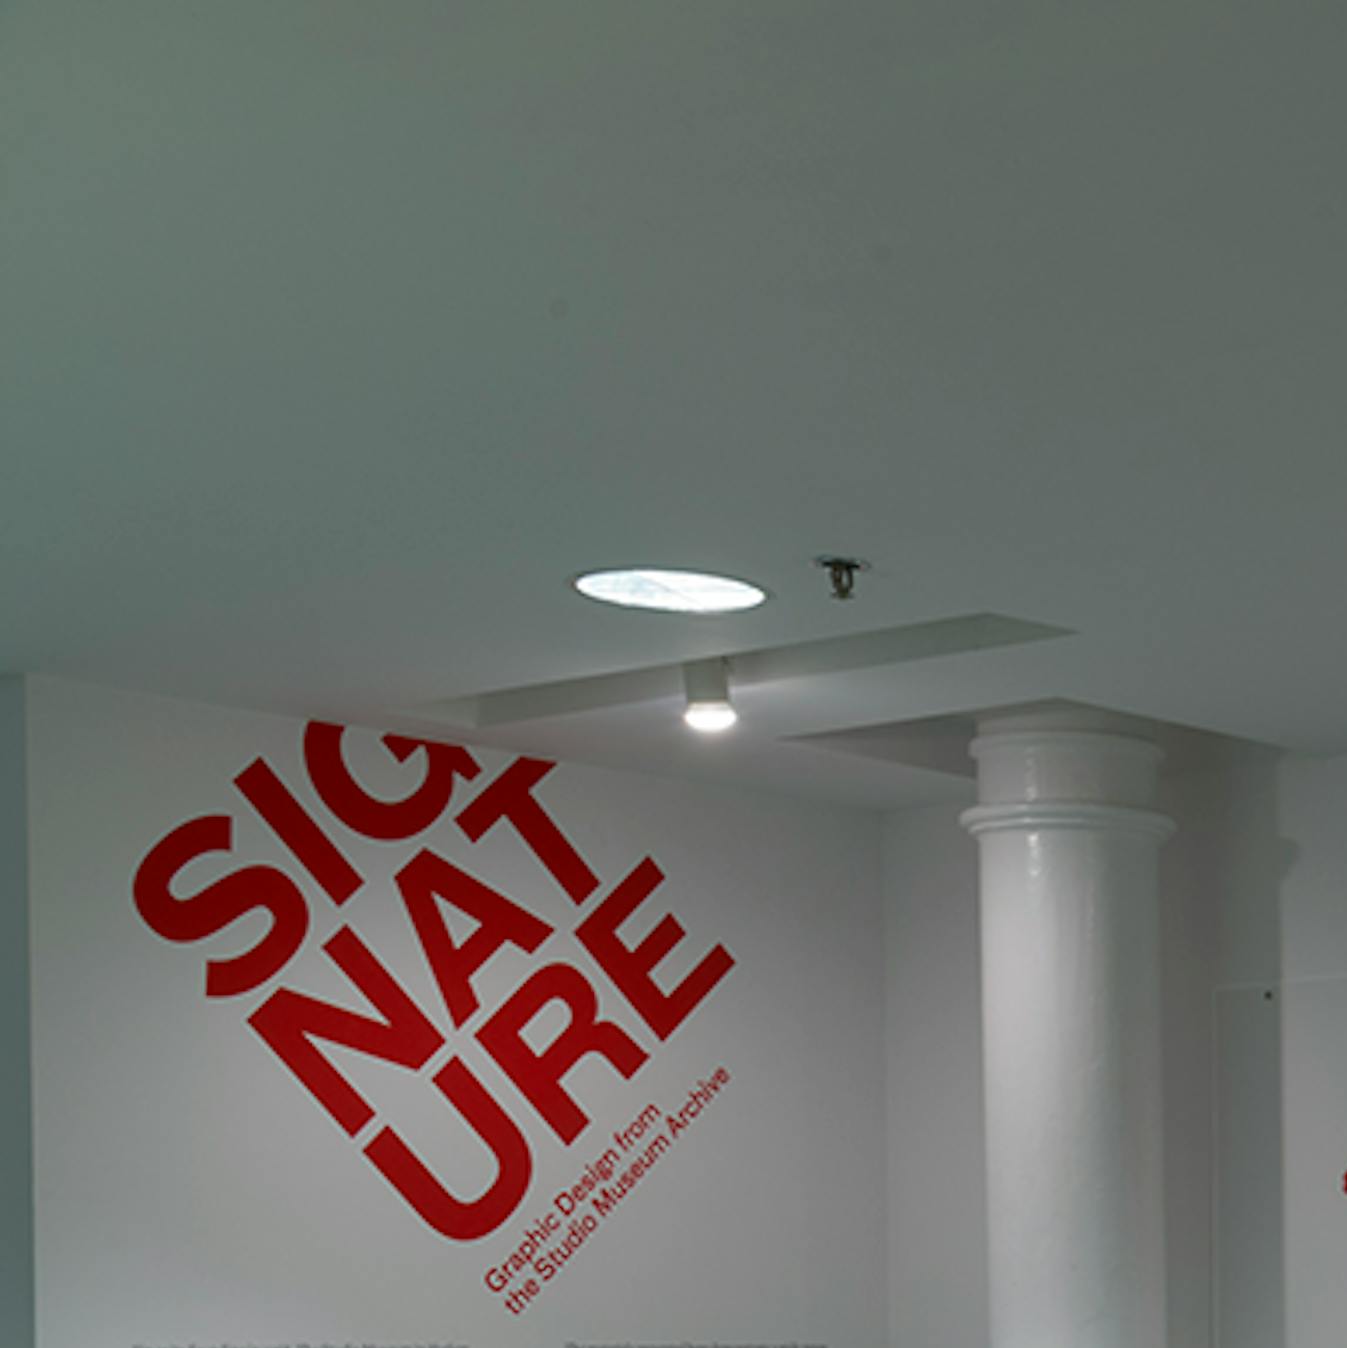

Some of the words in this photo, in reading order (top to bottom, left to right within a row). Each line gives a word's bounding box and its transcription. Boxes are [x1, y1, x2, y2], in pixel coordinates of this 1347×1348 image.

[246, 756, 600, 1139] NAT
[362, 855, 735, 1241] URE
[484, 1214, 561, 1292] Graphic
[554, 1149, 620, 1216] Design
[613, 1104, 661, 1152] from
[504, 1279, 540, 1315] the
[534, 1214, 598, 1281] Studio
[591, 1135, 671, 1217] Museum
[665, 1067, 730, 1139] Archive
